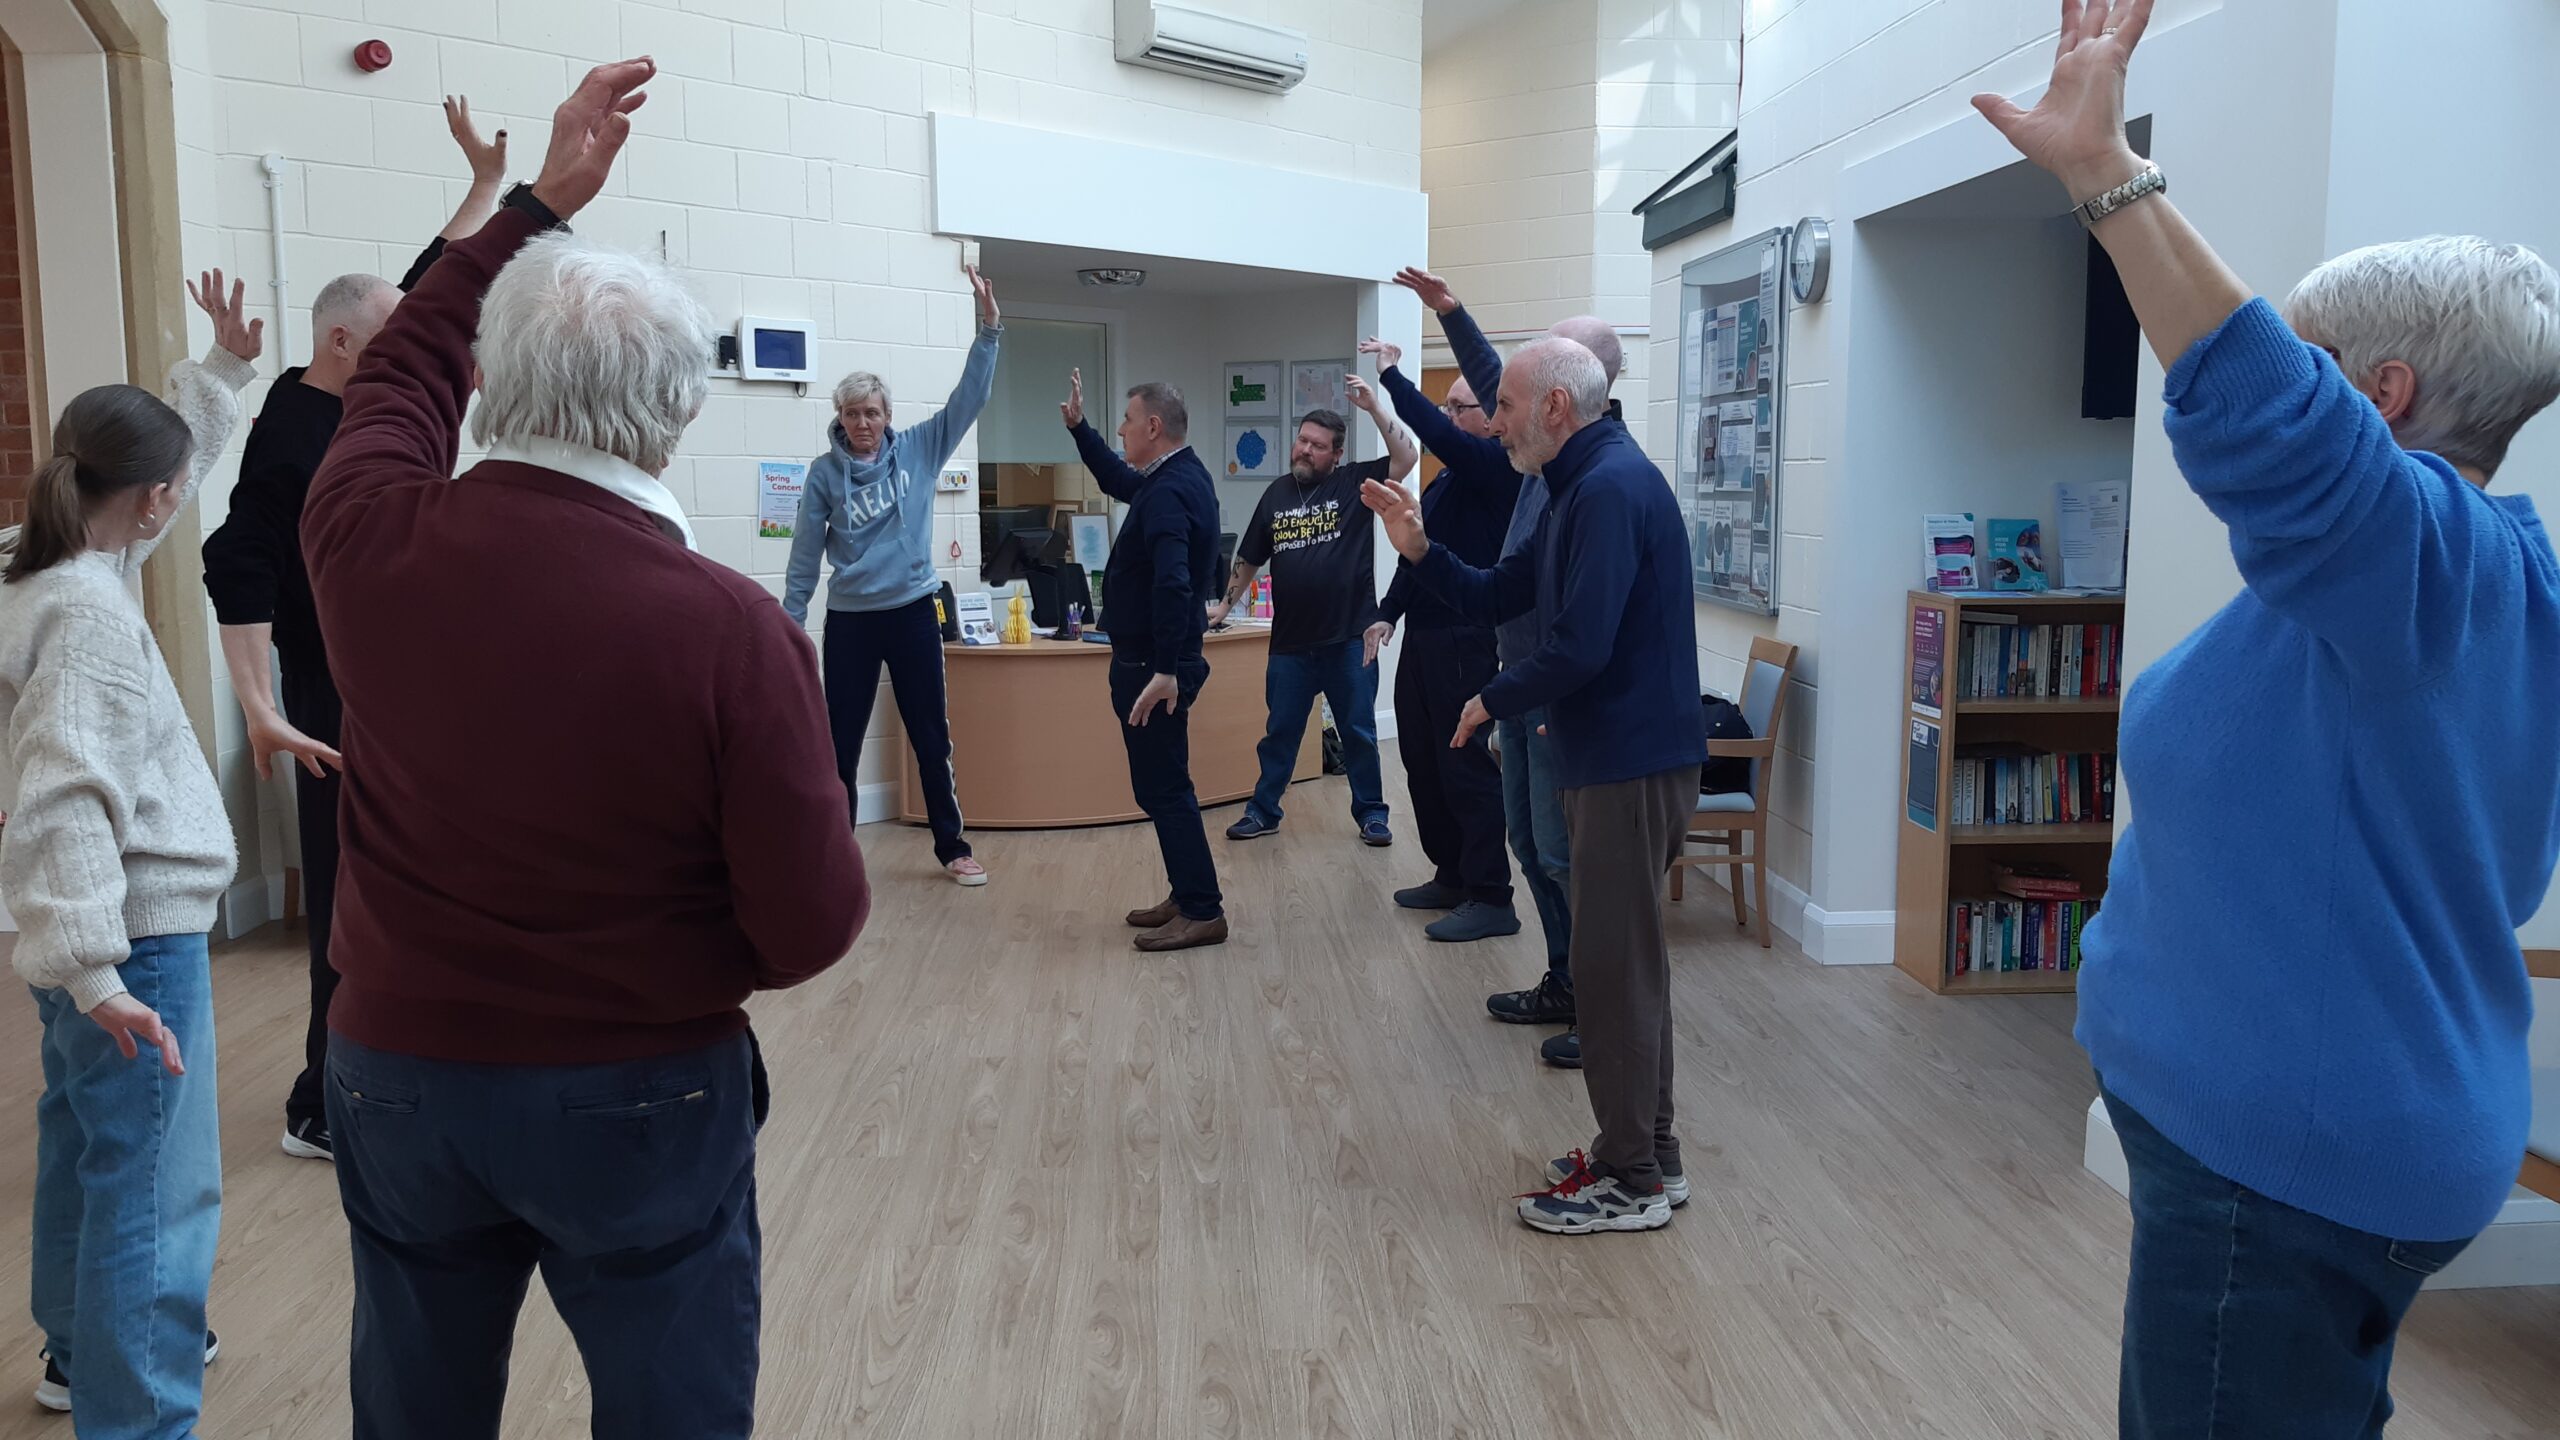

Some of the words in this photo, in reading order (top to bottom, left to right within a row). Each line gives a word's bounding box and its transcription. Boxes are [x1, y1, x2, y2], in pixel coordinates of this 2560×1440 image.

[765, 474, 790, 483] Spring
[772, 484, 802, 492] Concert
[842, 469, 910, 527] HELLO
[1274, 511, 1284, 520] SO
[1311, 504, 1321, 515] IS
[1307, 537, 1317, 546] TO
